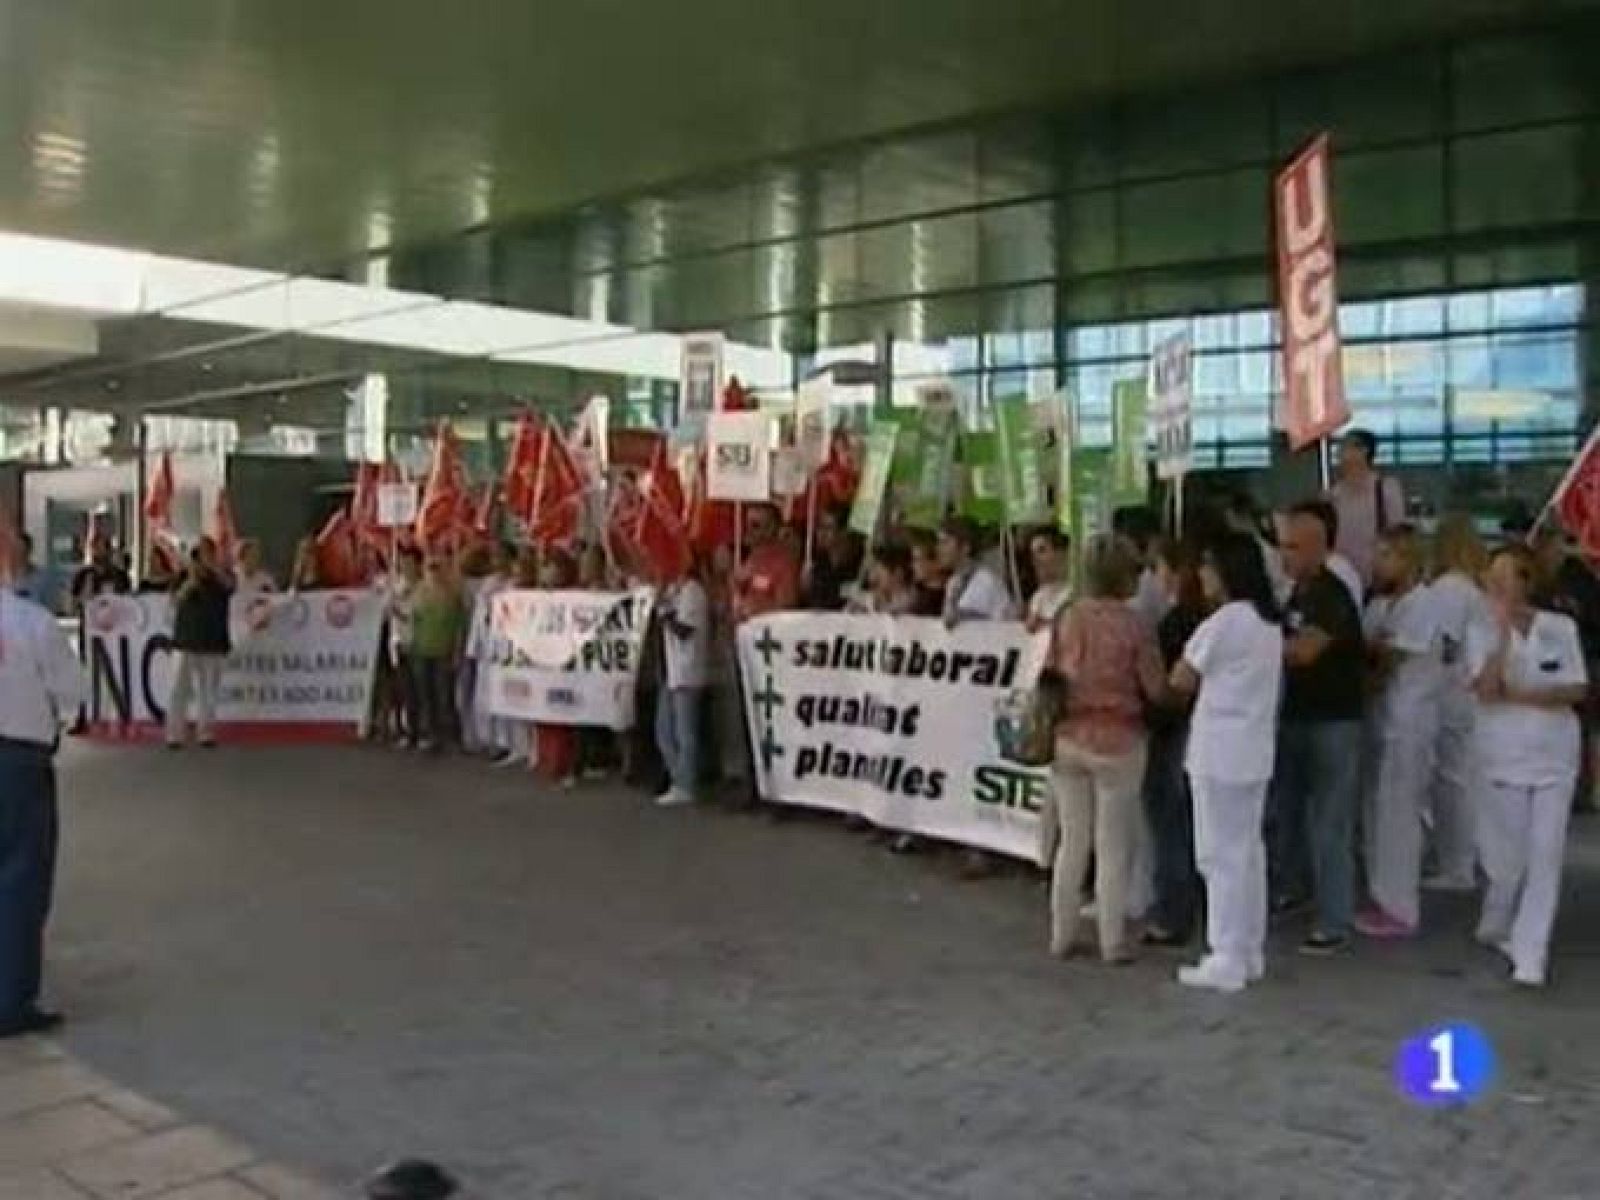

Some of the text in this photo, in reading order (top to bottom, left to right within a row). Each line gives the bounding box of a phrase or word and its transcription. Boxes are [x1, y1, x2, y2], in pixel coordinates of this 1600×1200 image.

[1285, 152, 1336, 424] UGT
[793, 635, 875, 670] salut
[879, 640, 1022, 688] laboral
